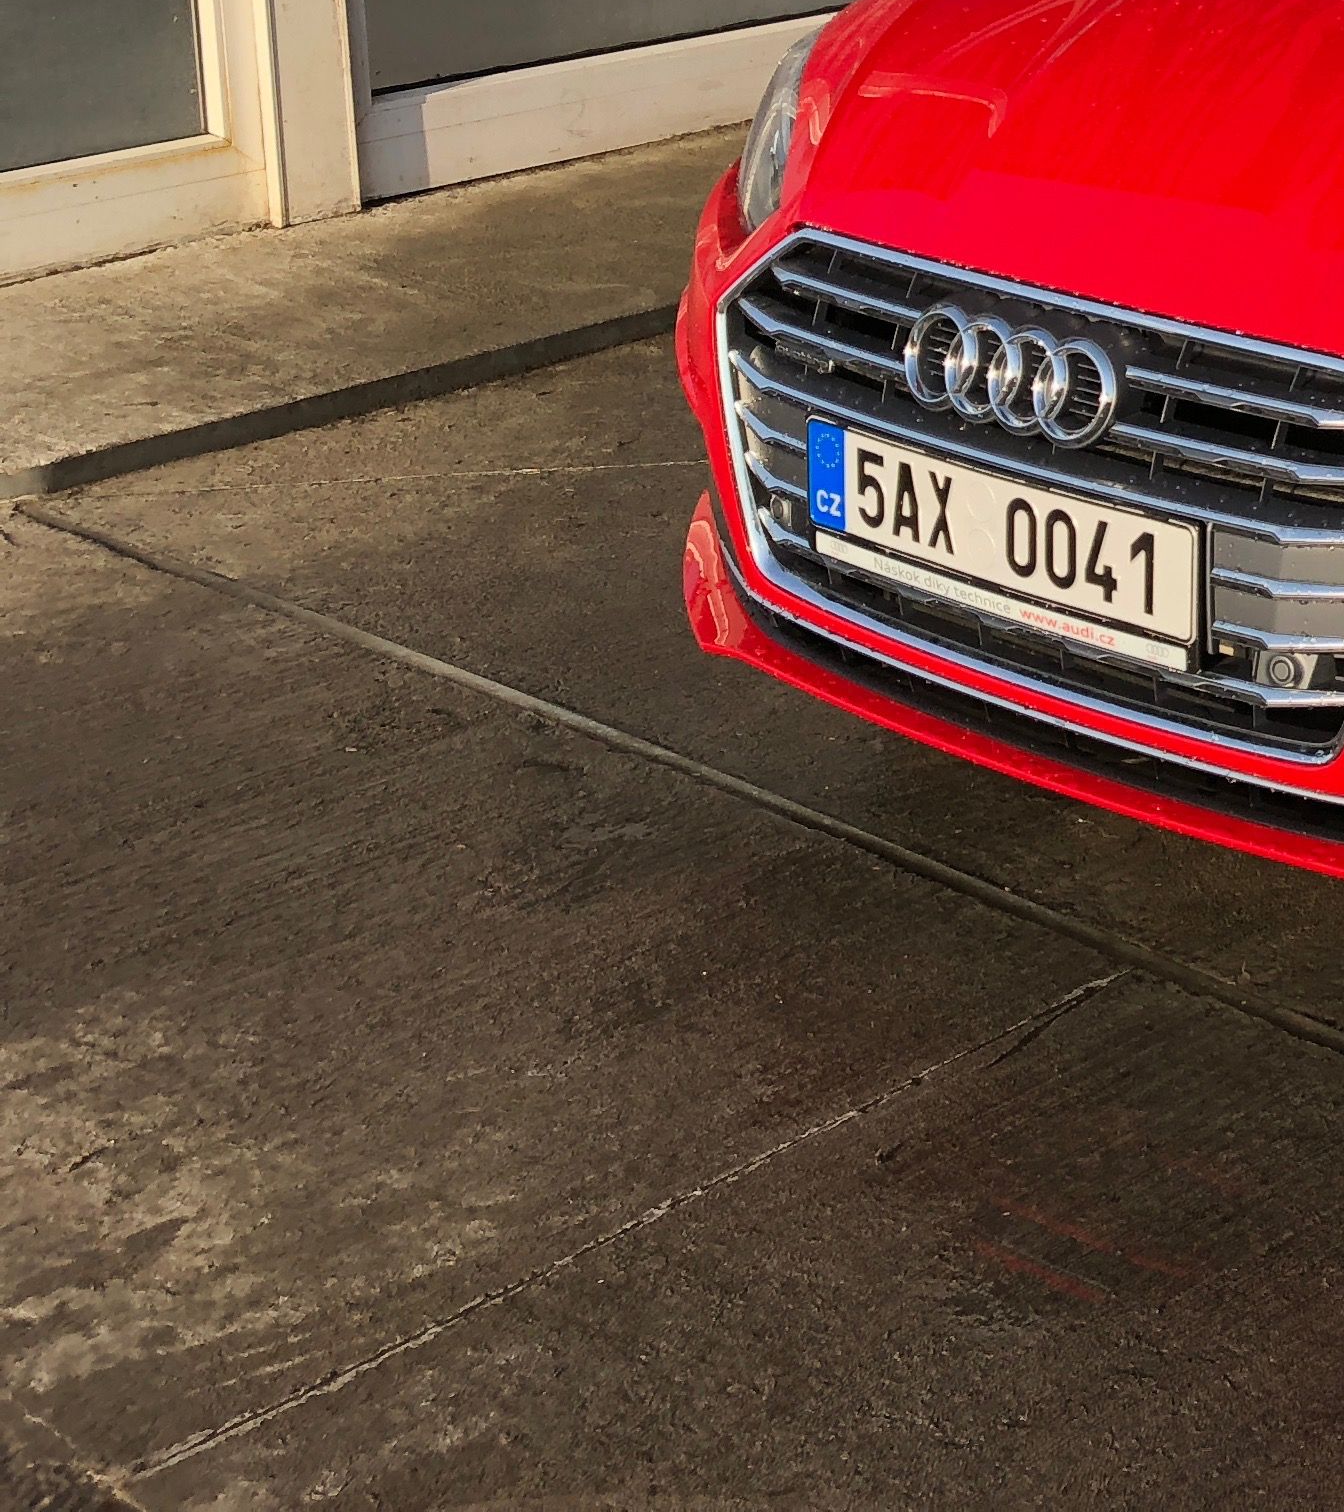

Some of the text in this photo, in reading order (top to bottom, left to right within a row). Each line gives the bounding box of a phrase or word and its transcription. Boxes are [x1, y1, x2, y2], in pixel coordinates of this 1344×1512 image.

[816, 489, 842, 518] CZ
[857, 447, 1155, 616] 5AX 0041
[873, 556, 922, 586] Náskok
[952, 587, 1012, 615] technice
[1018, 607, 1117, 647] www.audi.cz
